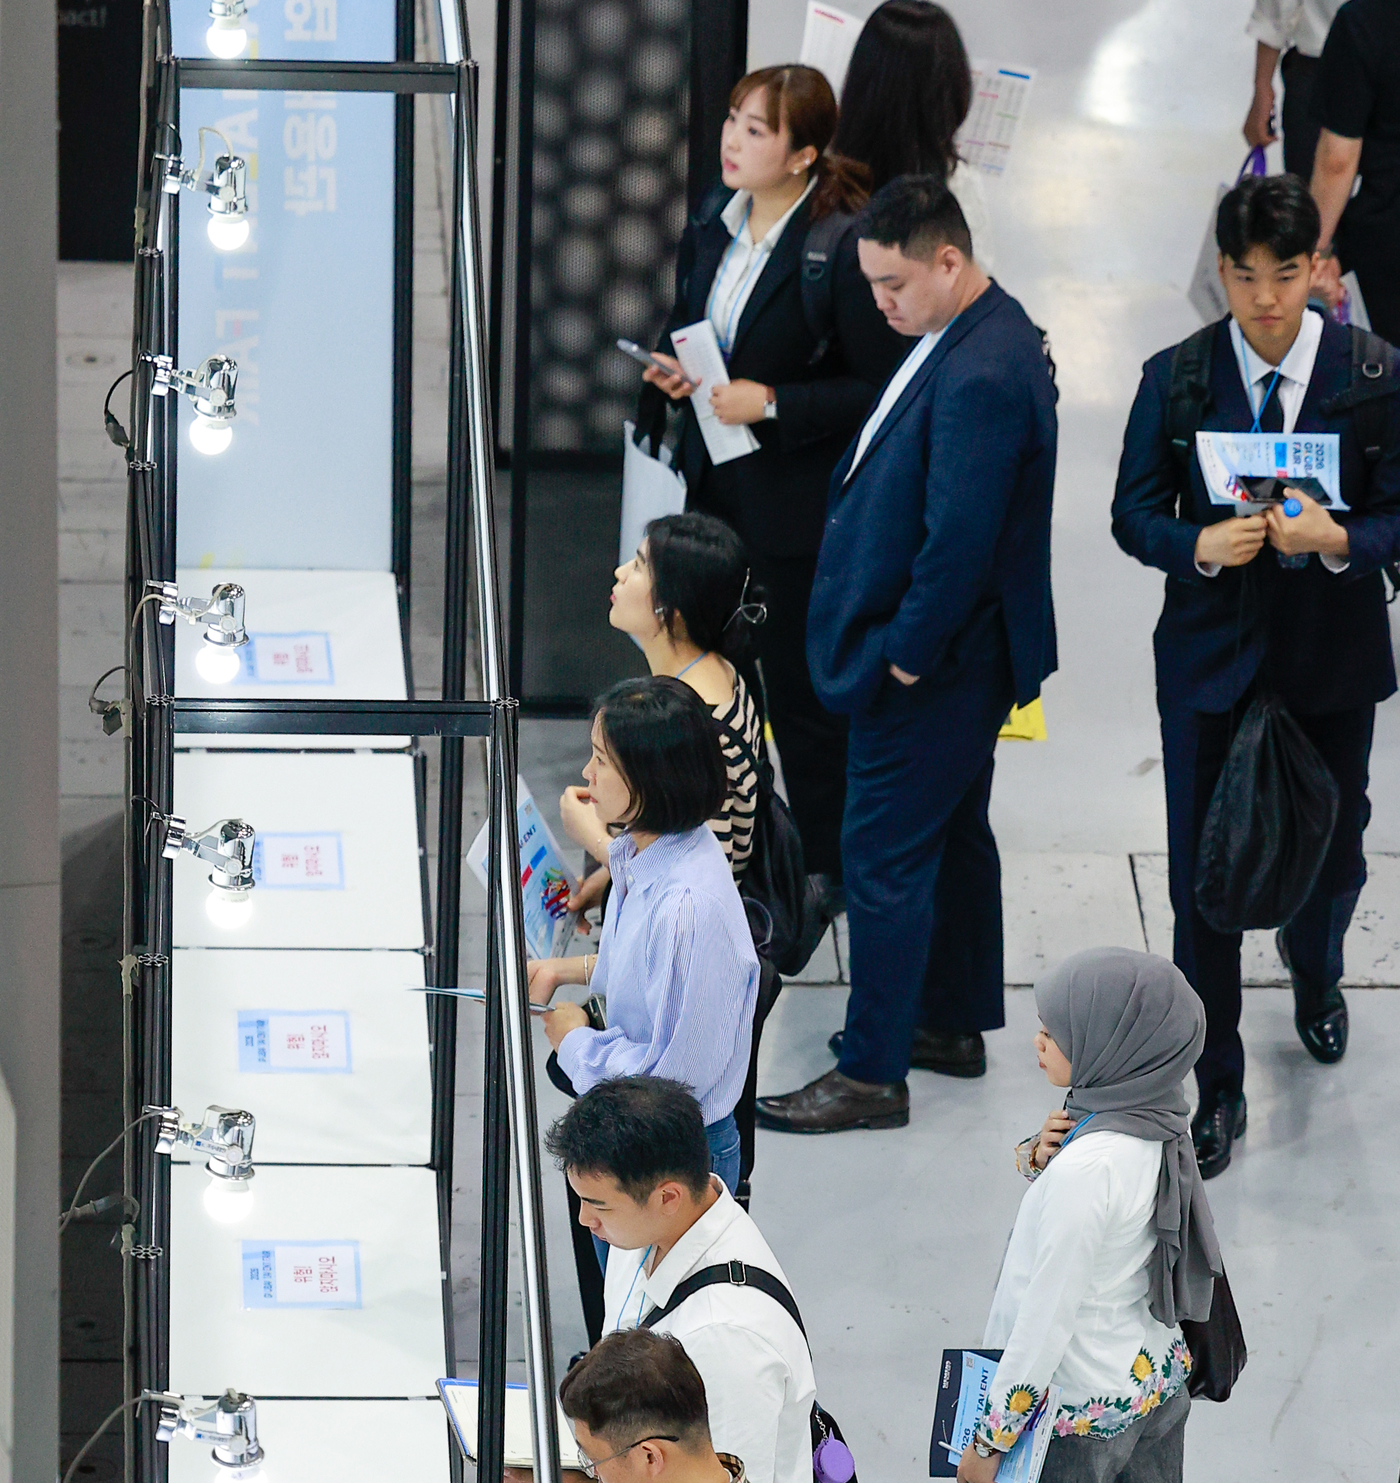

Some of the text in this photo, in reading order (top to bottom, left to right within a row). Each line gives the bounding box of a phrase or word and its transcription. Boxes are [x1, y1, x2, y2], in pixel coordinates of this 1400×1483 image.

[1293, 442, 1302, 465] FAIR
[1304, 442, 1313, 478] GLOBA
[1315, 443, 1325, 470] 2026
[293, 1266, 313, 1284] 위험!
[318, 1256, 339, 1293] 앉지마시오
[976, 1367, 990, 1412] TALENT
